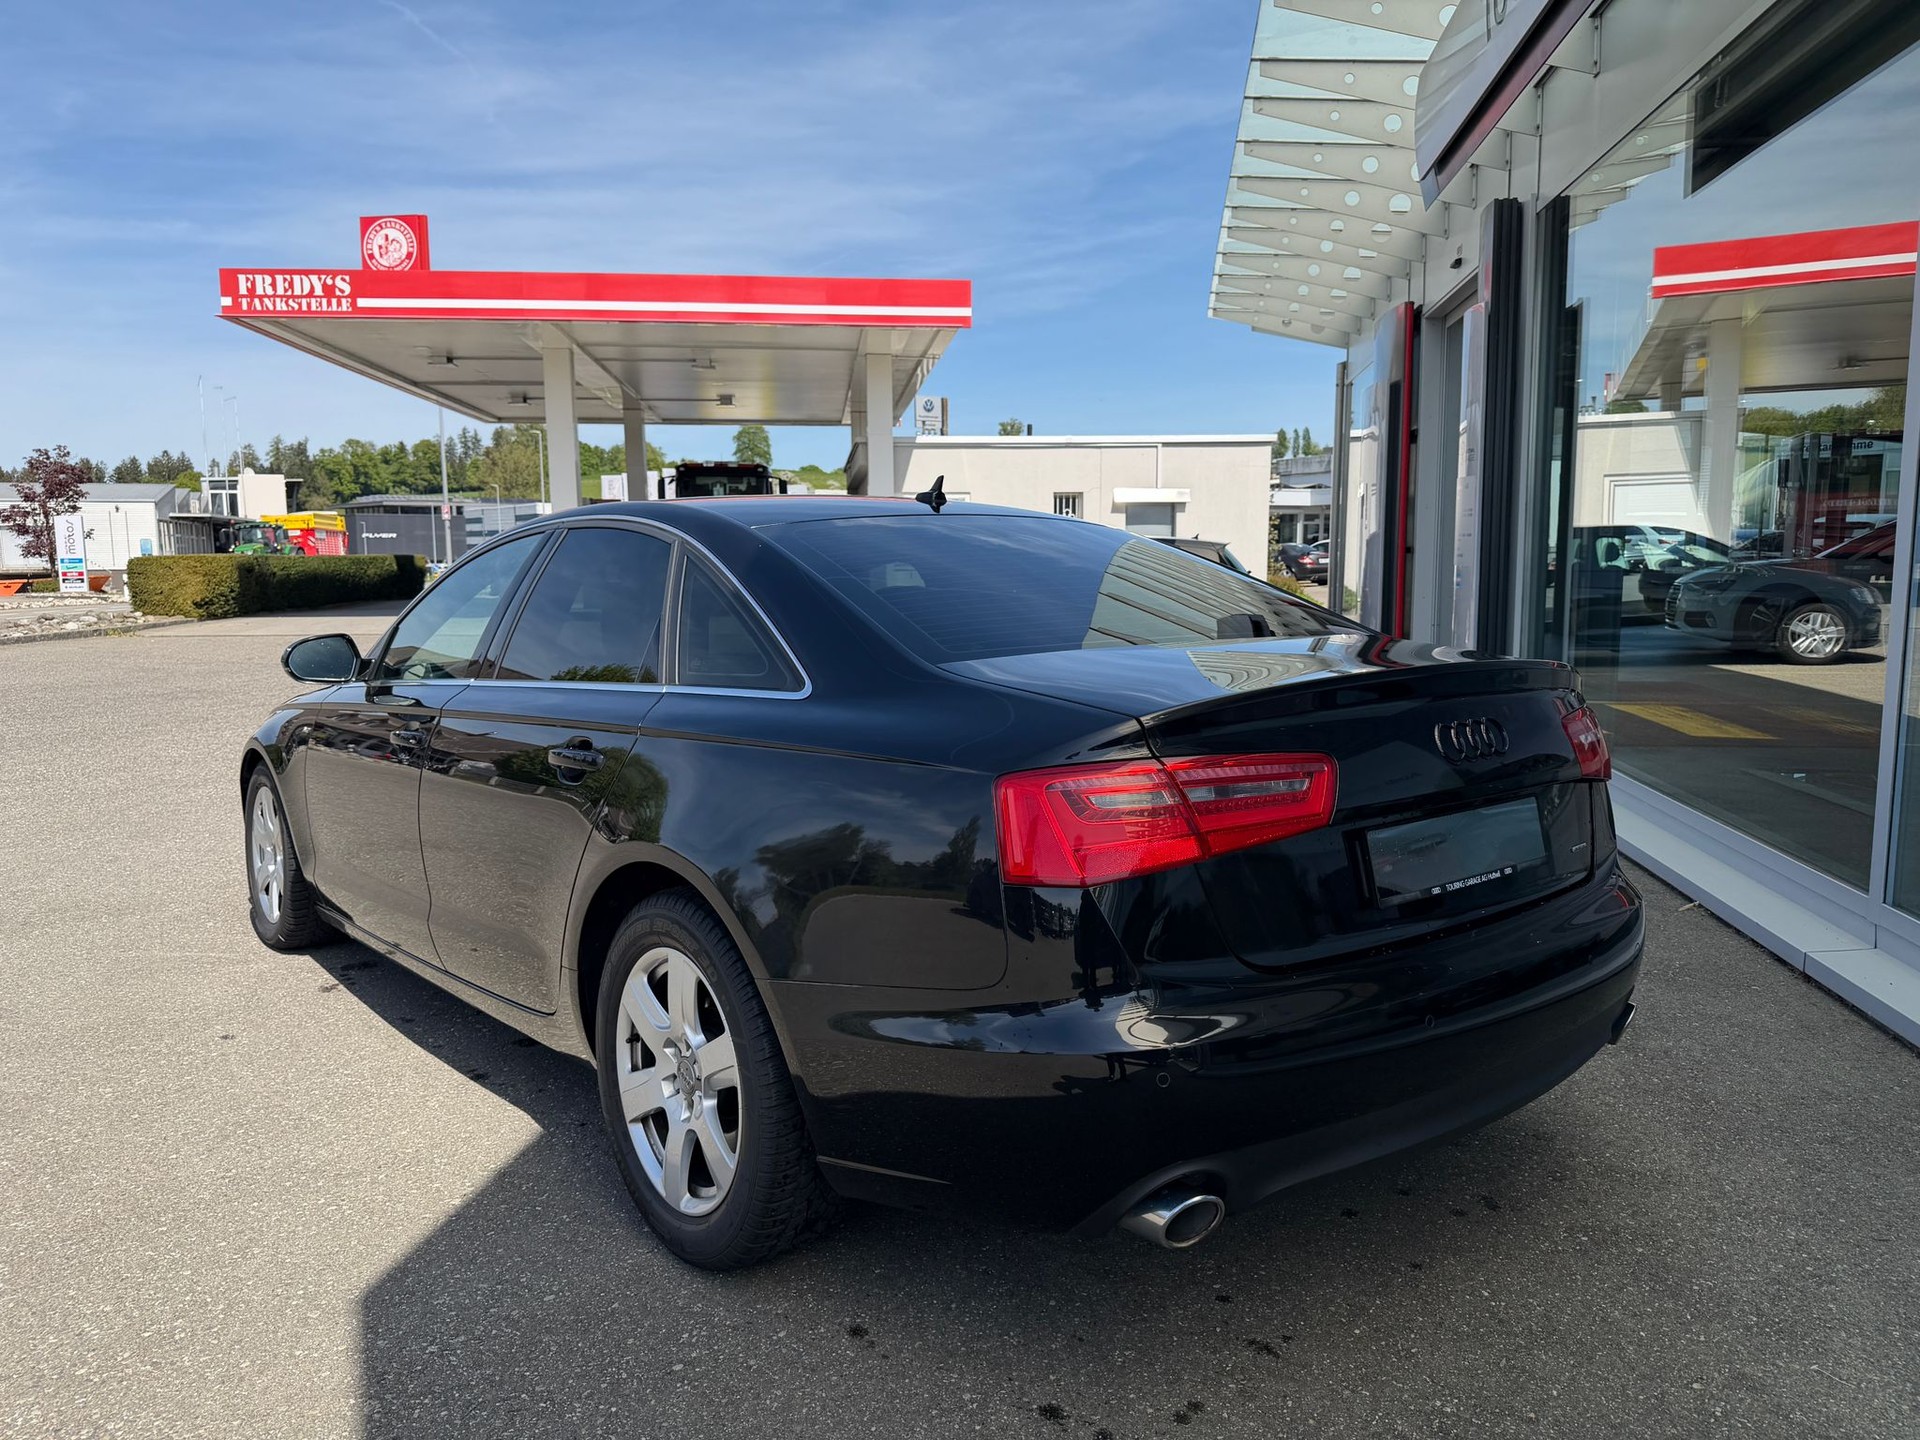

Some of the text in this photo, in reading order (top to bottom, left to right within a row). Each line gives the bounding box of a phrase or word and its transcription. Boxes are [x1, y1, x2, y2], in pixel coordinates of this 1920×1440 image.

[237, 274, 351, 296] FREDY'S
[238, 297, 352, 312] TANKSTELLE
[1445, 881, 1465, 892] TOURING
[1465, 876, 1482, 886] GARAGE
